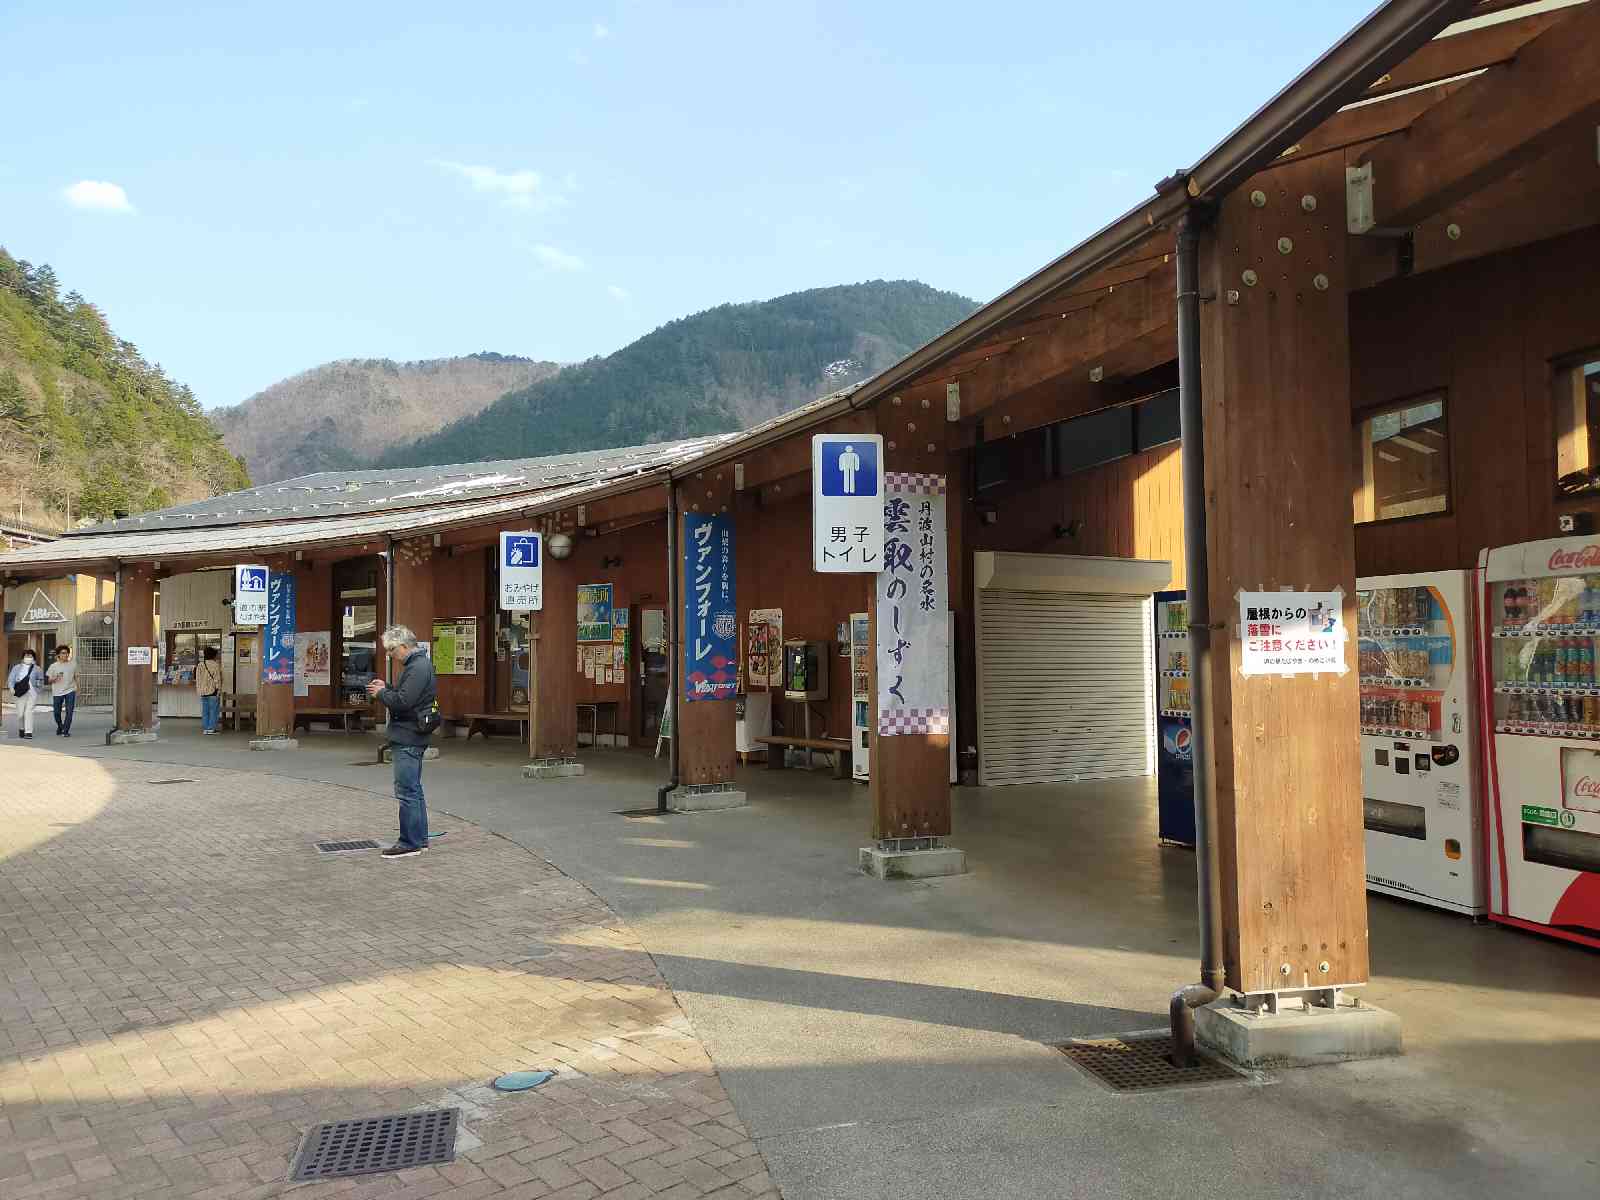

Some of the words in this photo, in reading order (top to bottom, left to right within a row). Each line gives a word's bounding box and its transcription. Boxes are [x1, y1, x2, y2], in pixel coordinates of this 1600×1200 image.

[831, 526, 870, 543] 男子
[823, 545, 877, 563] トイレ
[918, 501, 936, 612] 丹波山村の名水
[504, 583, 540, 593] おみやげ
[694, 521, 713, 661] ヴァンフォーレ
[505, 595, 539, 605] 直売所
[269, 578, 281, 661] ヴァンフォーレ
[1246, 607, 1307, 621] 屋根からの
[1247, 623, 1282, 637] 落雪に
[1248, 639, 1337, 652] ご注意ください！
